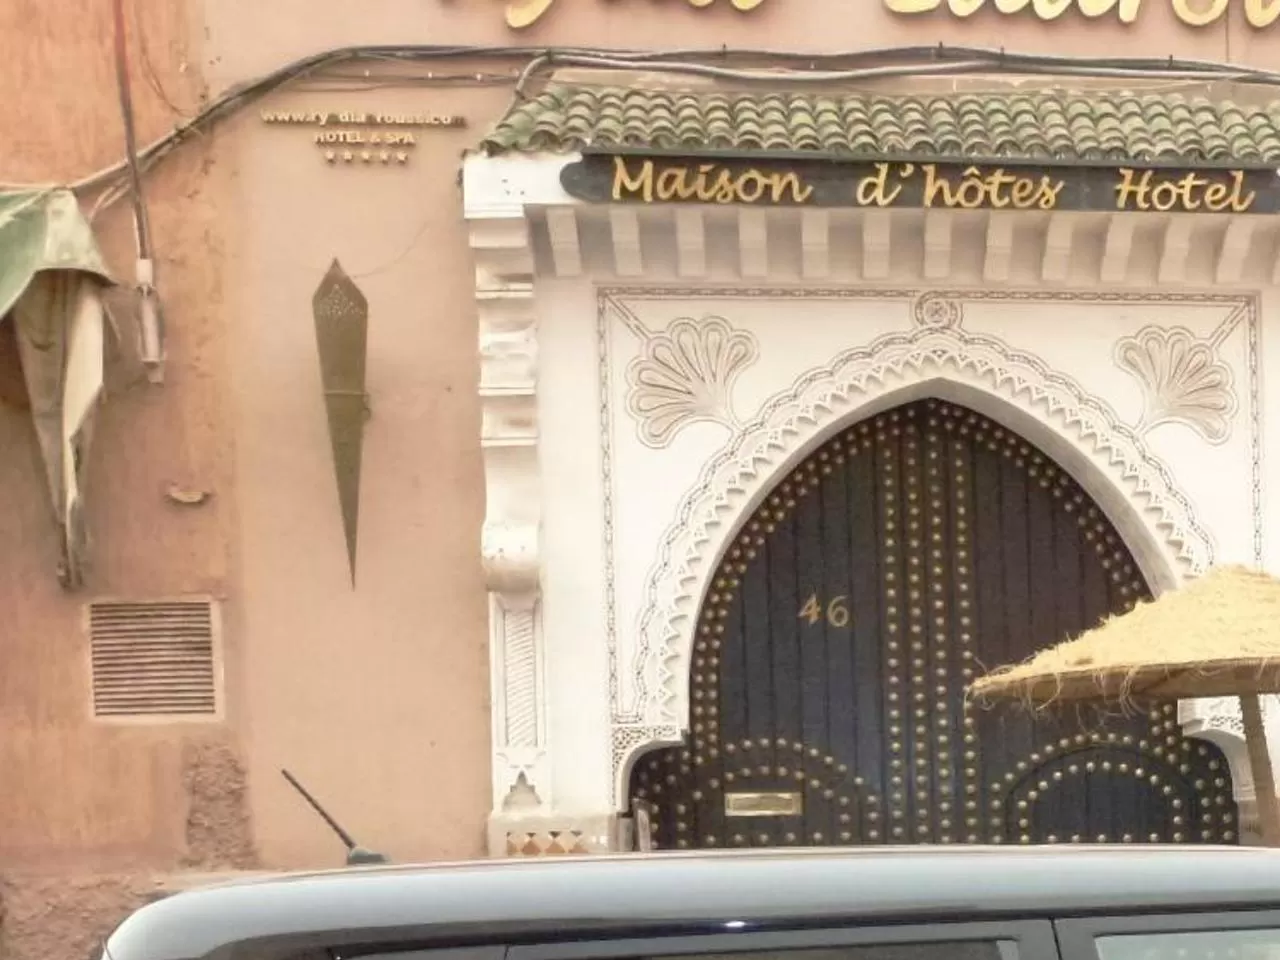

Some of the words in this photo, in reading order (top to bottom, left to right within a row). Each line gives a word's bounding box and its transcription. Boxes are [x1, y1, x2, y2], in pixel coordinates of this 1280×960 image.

[314, 131, 364, 144] HOTEL
[386, 131, 416, 144] SPA
[611, 156, 813, 203] Maison
[855, 162, 1064, 208] d'hôtes
[1114, 167, 1256, 212] Hotel
[798, 592, 848, 628] 46
